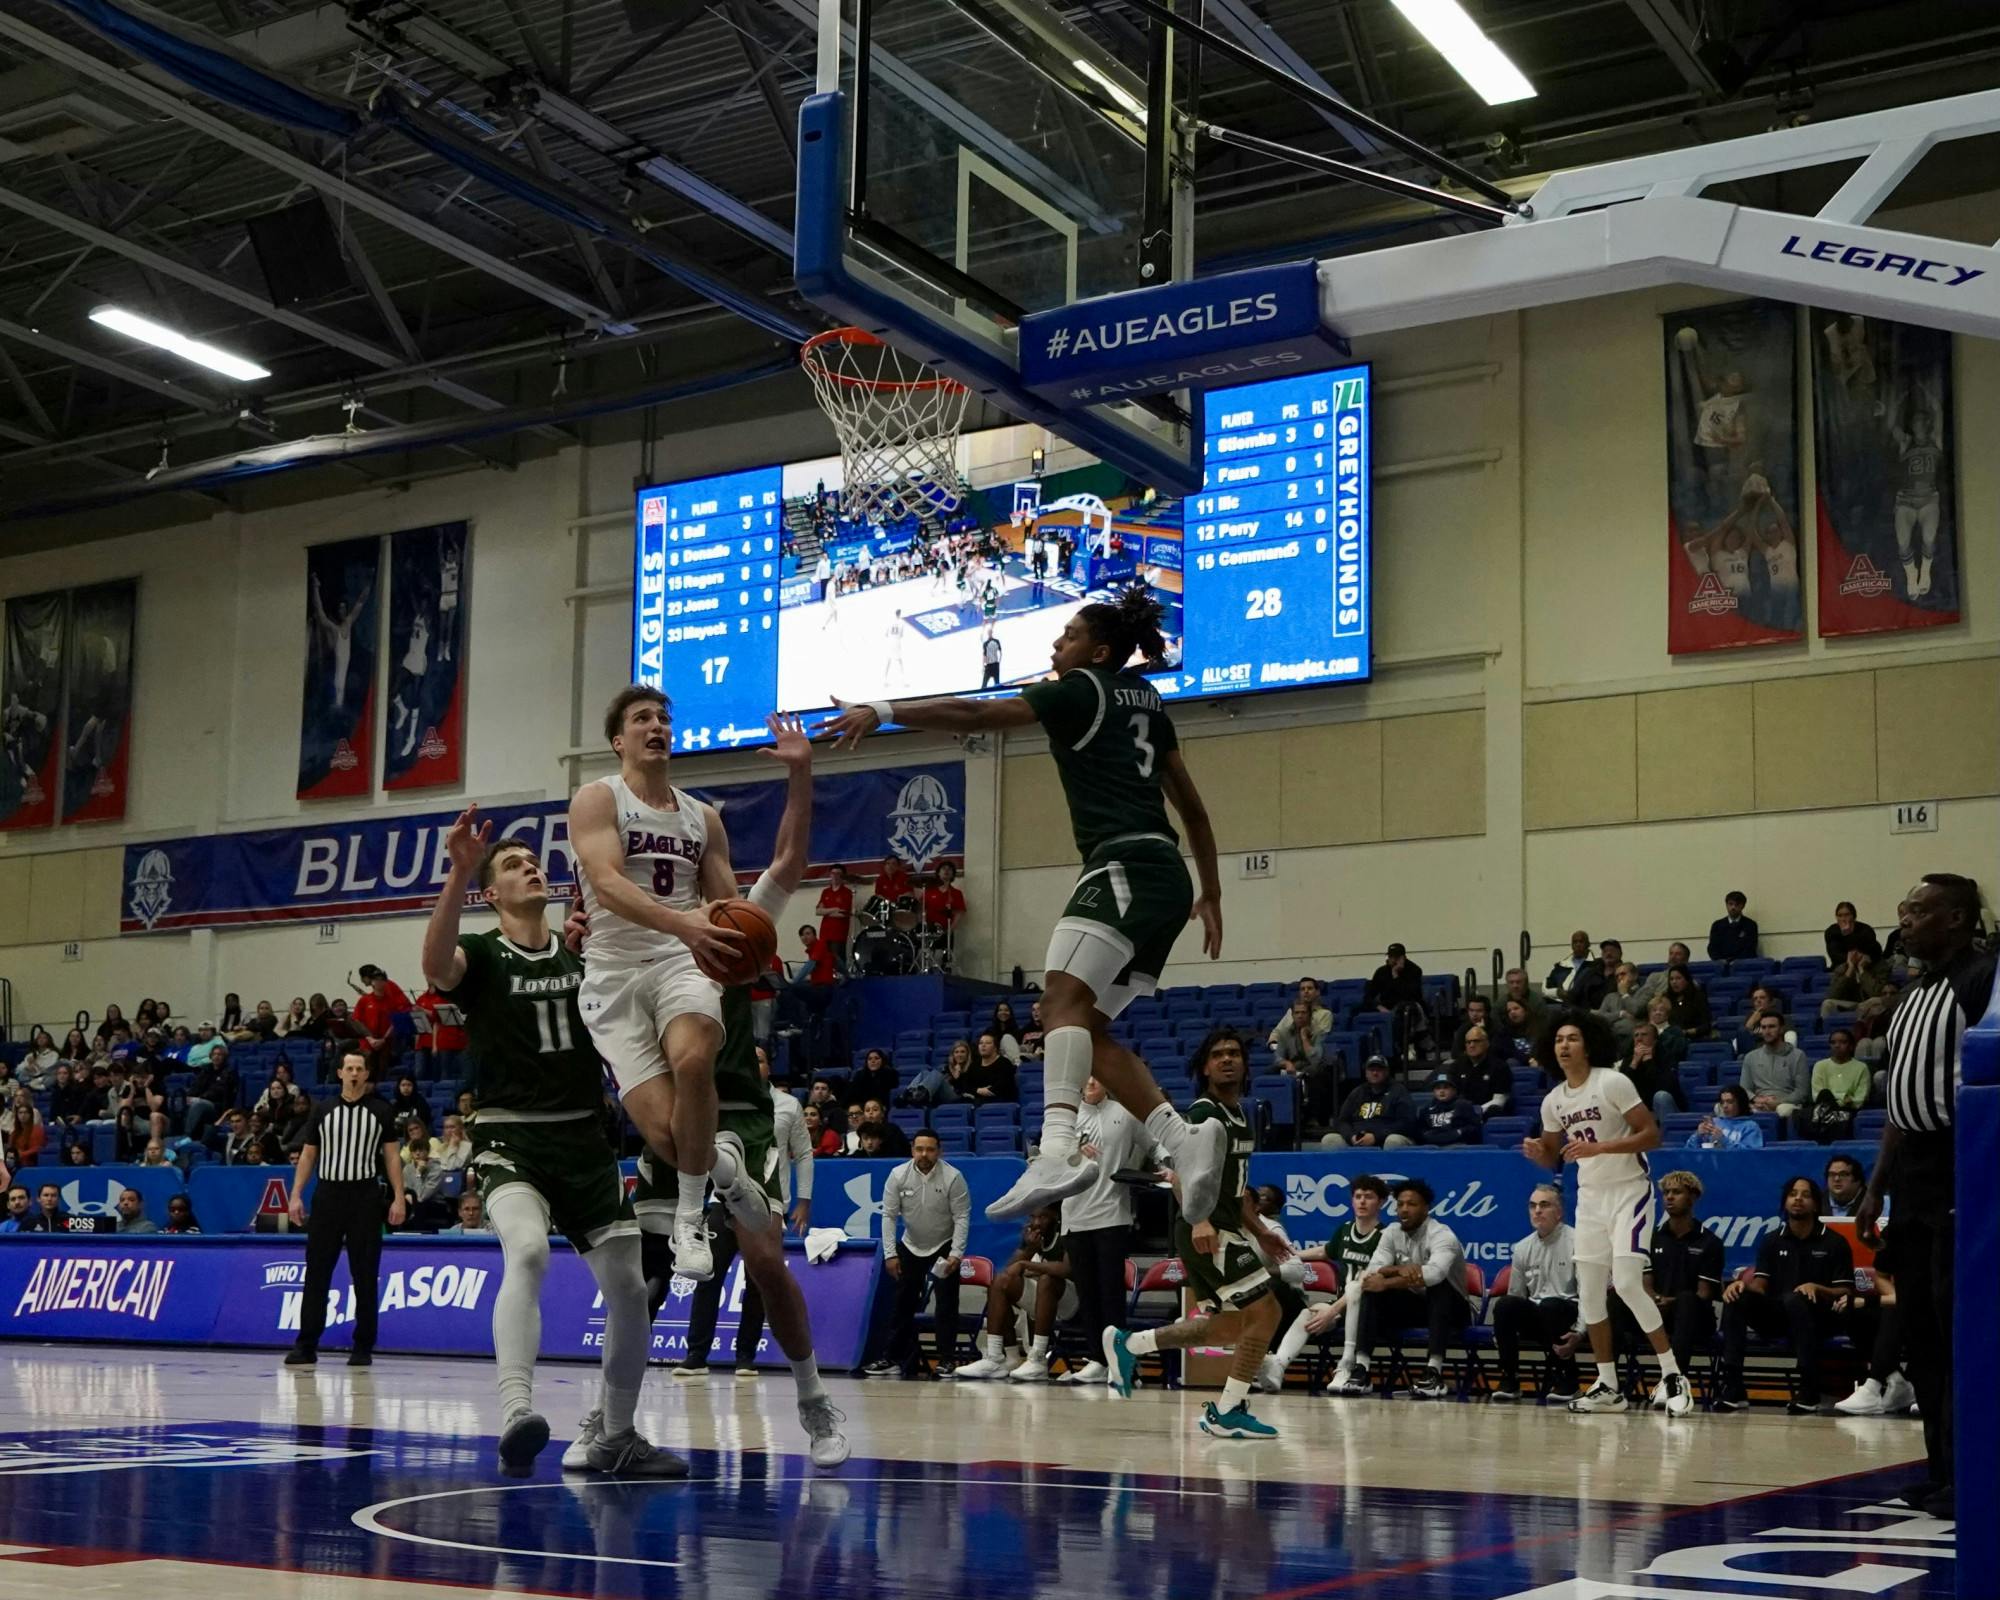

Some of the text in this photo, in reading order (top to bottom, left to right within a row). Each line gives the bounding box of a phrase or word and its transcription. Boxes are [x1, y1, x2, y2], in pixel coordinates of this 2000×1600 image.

[1780, 235, 1987, 286] LEGACY
[1046, 293, 1278, 359] #AUEAGLES
[1069, 351, 1303, 400] #AUEAGLES
[1221, 400, 1328, 429] PLAYER PTS FLS
[1286, 427, 1297, 443] 3
[1313, 422, 1325, 438] 0
[1314, 452, 1323, 468] 1
[1197, 498, 1214, 515] 11
[1287, 483, 1298, 499] 2
[1315, 479, 1324, 495] 1
[670, 527, 679, 541] 4
[742, 515, 752, 530] 3
[765, 511, 772, 526] 1
[1197, 525, 1215, 542] 12
[1285, 511, 1303, 528] 14
[1315, 508, 1326, 524] 0
[1339, 416, 1359, 626] GREYHOUNDS
[742, 540, 751, 555] 4
[1197, 553, 1215, 571] 15
[1316, 538, 1327, 553] 0
[668, 576, 682, 591] 15
[1245, 588, 1282, 619] 28
[640, 552, 663, 688] EAGLES
[739, 618, 749, 633] 2
[701, 656, 730, 685] 17
[1127, 712, 1155, 778] 3
[1898, 806, 1927, 824] 116
[627, 831, 700, 867] EAGLES
[1247, 855, 1269, 870] 115
[652, 859, 674, 896] 8
[532, 998, 575, 1053] 11
[1561, 1106, 1601, 1130] EAGLES
[68, 1217, 94, 1230] POSS
[14, 1258, 174, 1321] AMERICAN
[265, 1265, 298, 1284] WHO
